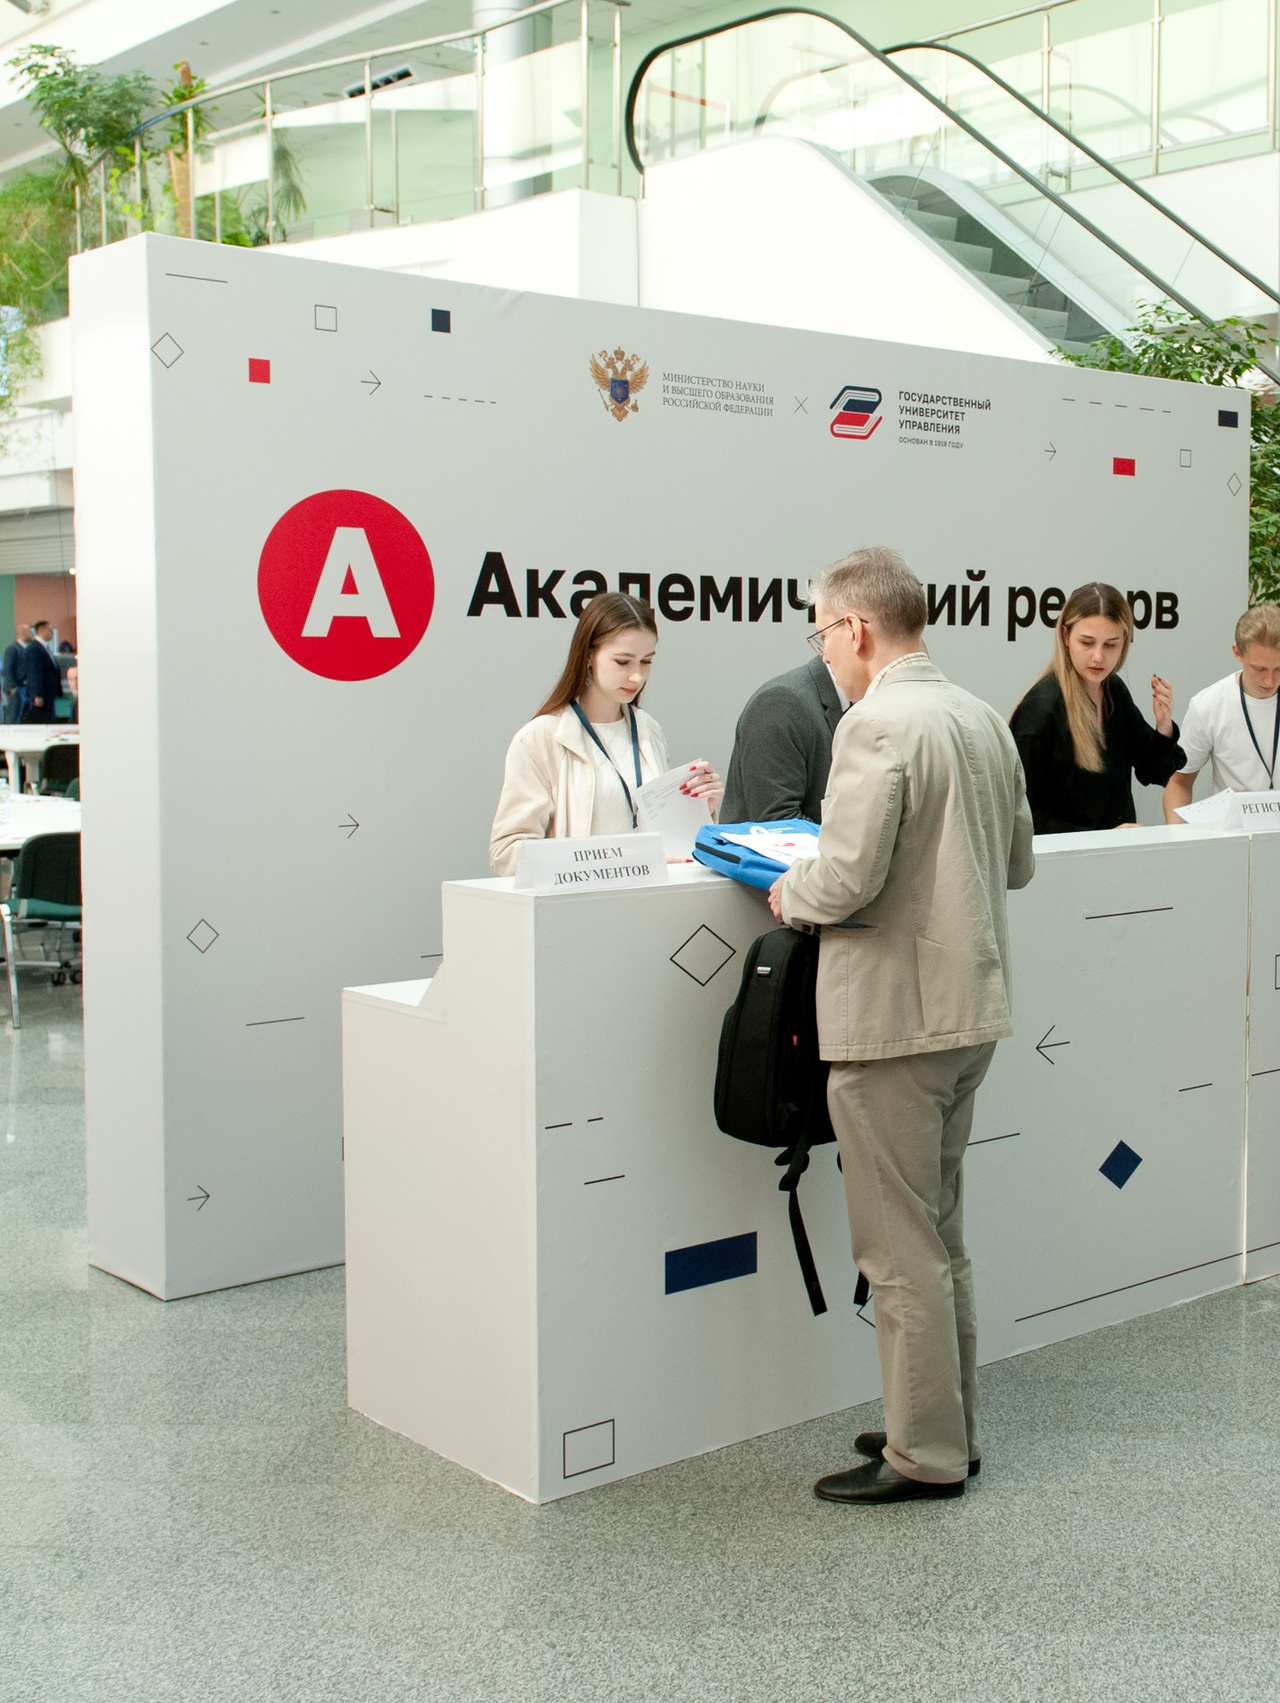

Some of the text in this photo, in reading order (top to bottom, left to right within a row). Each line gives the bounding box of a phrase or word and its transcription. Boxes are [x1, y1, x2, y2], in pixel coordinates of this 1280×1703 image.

[661, 372, 765, 393] МИНИСТЕРСТВО НАУКИ
[662, 384, 774, 406] И ВЫСШЕГО ОБРАЗОВАНИЯ
[898, 391, 992, 411] ГОСУДАРСТВЕННЫЙ
[662, 396, 774, 417] РОССИЙСКОЙ ФЕДЕРАЦИИ
[898, 405, 966, 421] УНИВЕРСИТЕТ
[898, 419, 961, 435] УПРАВЛЕНИЯ
[898, 436, 928, 446] ОСНОВАН
[948, 441, 964, 449] ГОДУ
[466, 551, 1180, 643] Академичий рерв
[573, 847, 623, 862] ПРИЕМ
[554, 864, 650, 886] ДОКУМЕНТОВ
